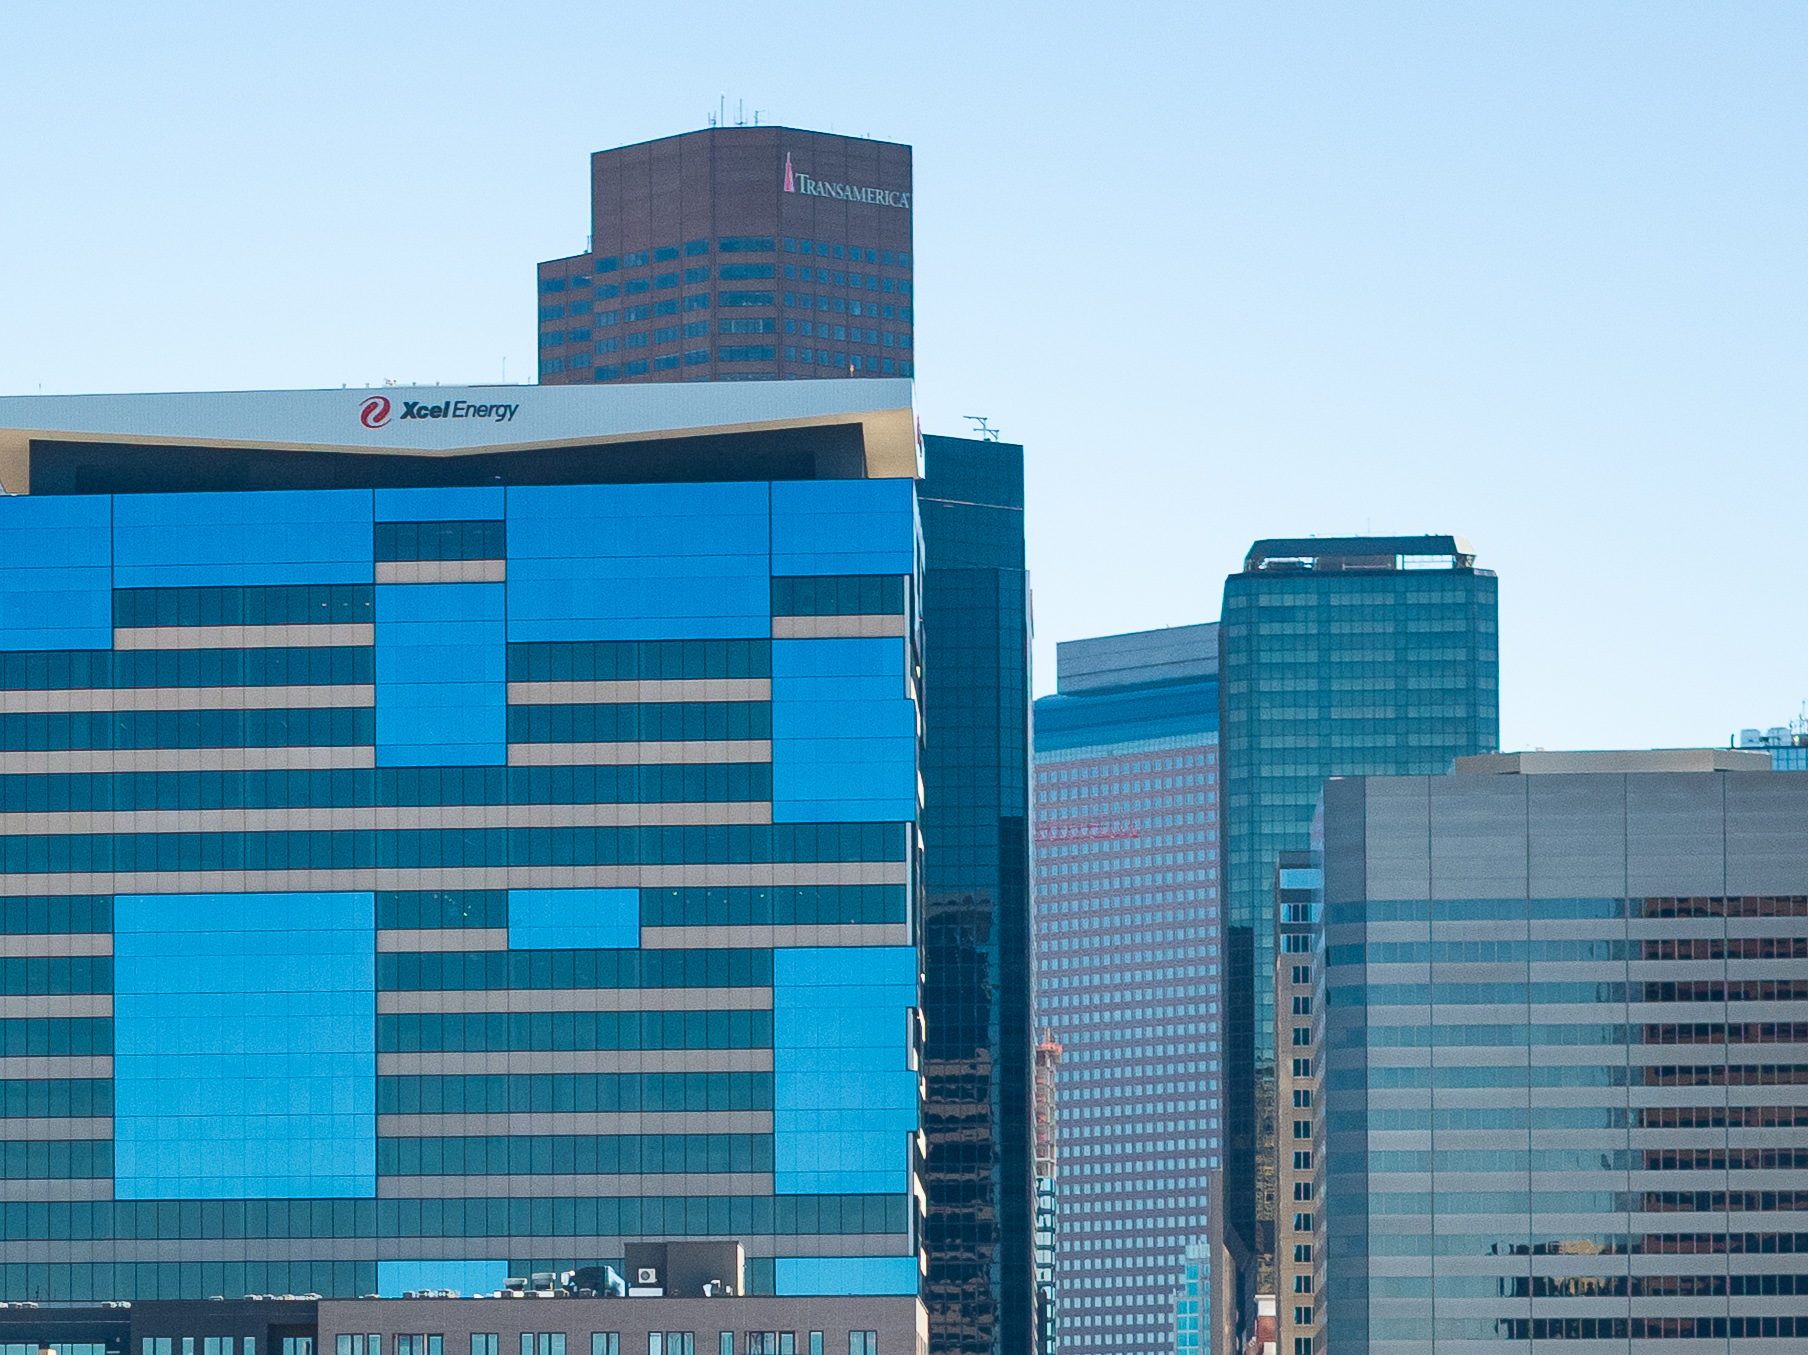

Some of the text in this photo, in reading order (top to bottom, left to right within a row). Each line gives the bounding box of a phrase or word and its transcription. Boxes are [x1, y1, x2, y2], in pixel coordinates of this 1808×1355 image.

[795, 173, 909, 208] TRANSAMERICA
[399, 400, 520, 422] Xcel Energy
